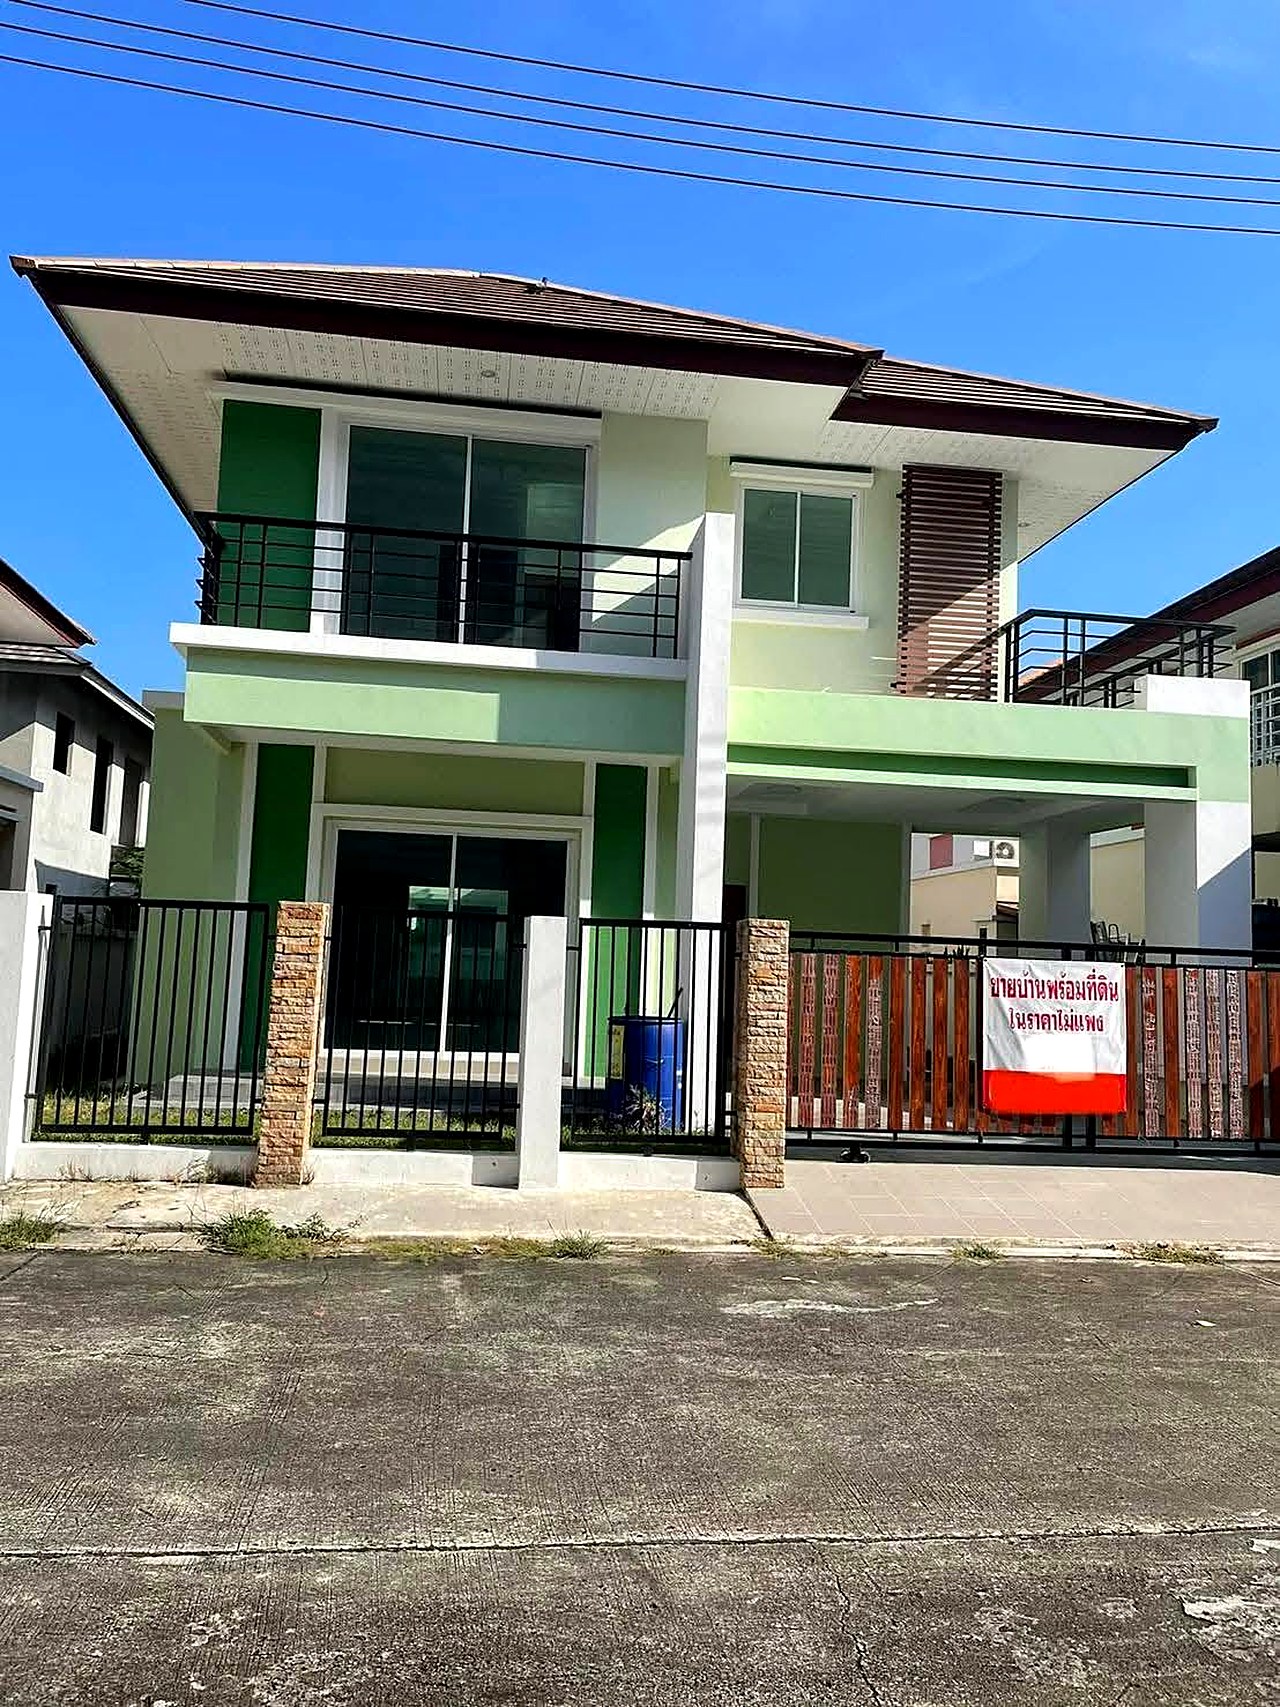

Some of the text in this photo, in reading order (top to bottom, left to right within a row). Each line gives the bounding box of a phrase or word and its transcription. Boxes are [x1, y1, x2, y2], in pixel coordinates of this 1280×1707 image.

[990, 969, 1119, 1001] ขายบ้านพร้อมที่ดิน
[1009, 1007, 1104, 1032] ในราคาไม่แพง
